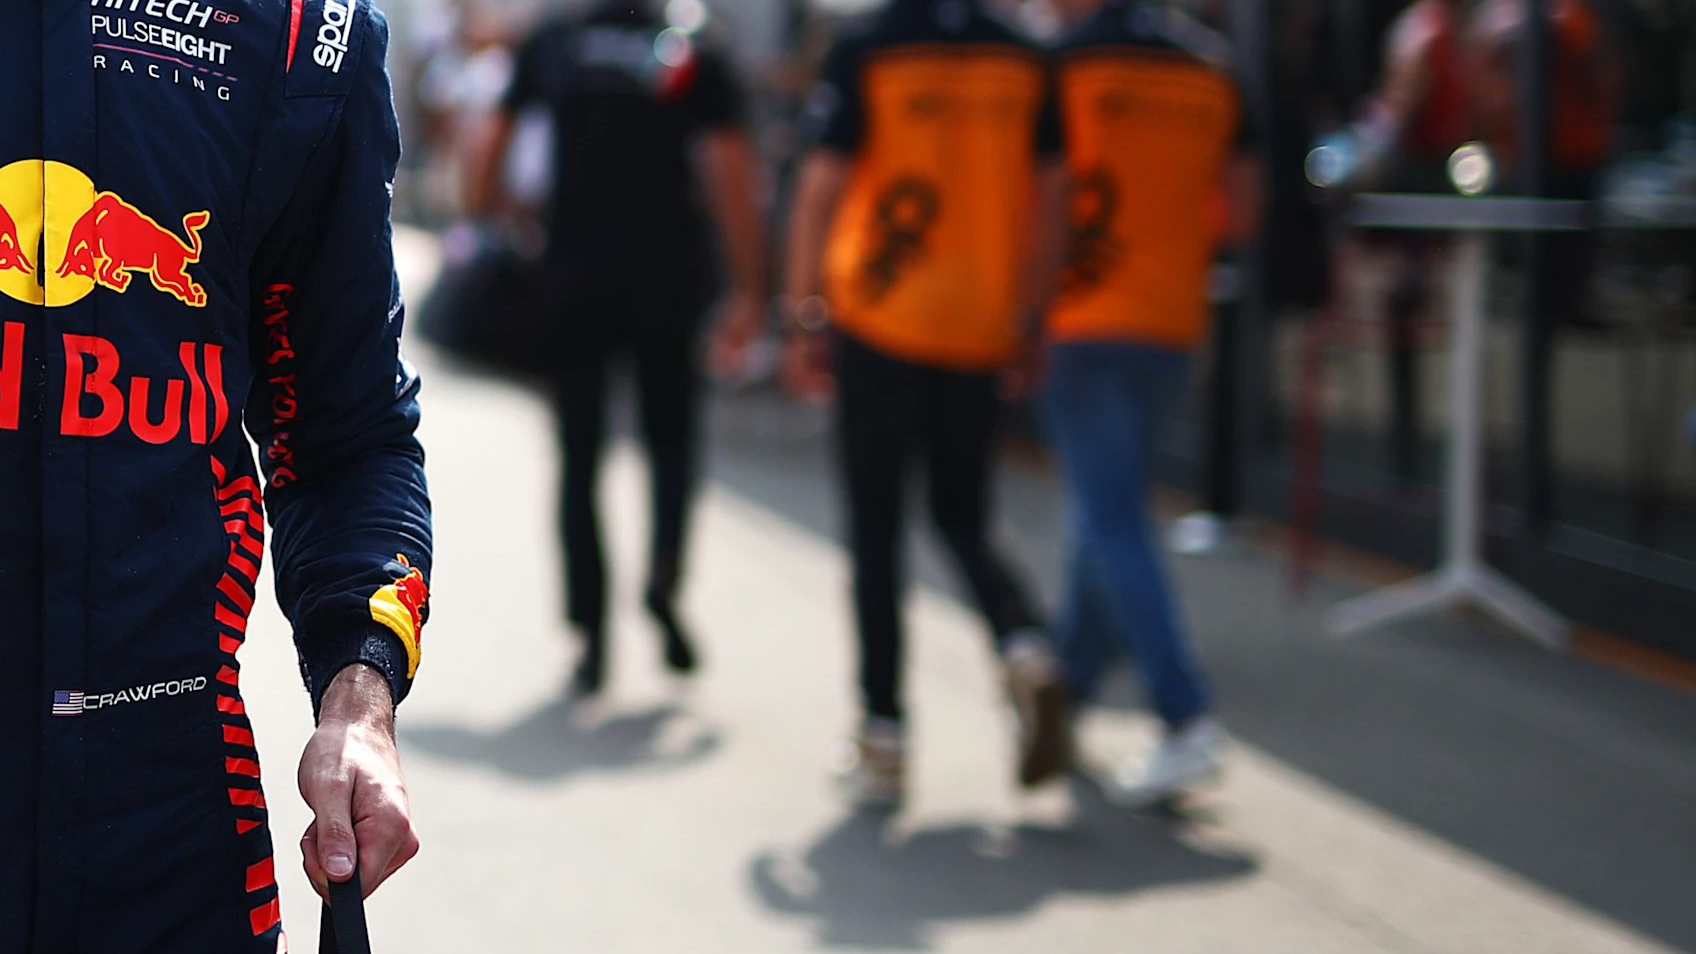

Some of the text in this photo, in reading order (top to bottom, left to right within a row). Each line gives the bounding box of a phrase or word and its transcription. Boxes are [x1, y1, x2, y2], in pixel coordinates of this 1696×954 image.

[213, 10, 240, 24] GP
[93, 55, 230, 101] RACING
[60, 333, 229, 445] Bull
[82, 676, 207, 710] CRAWFORD
